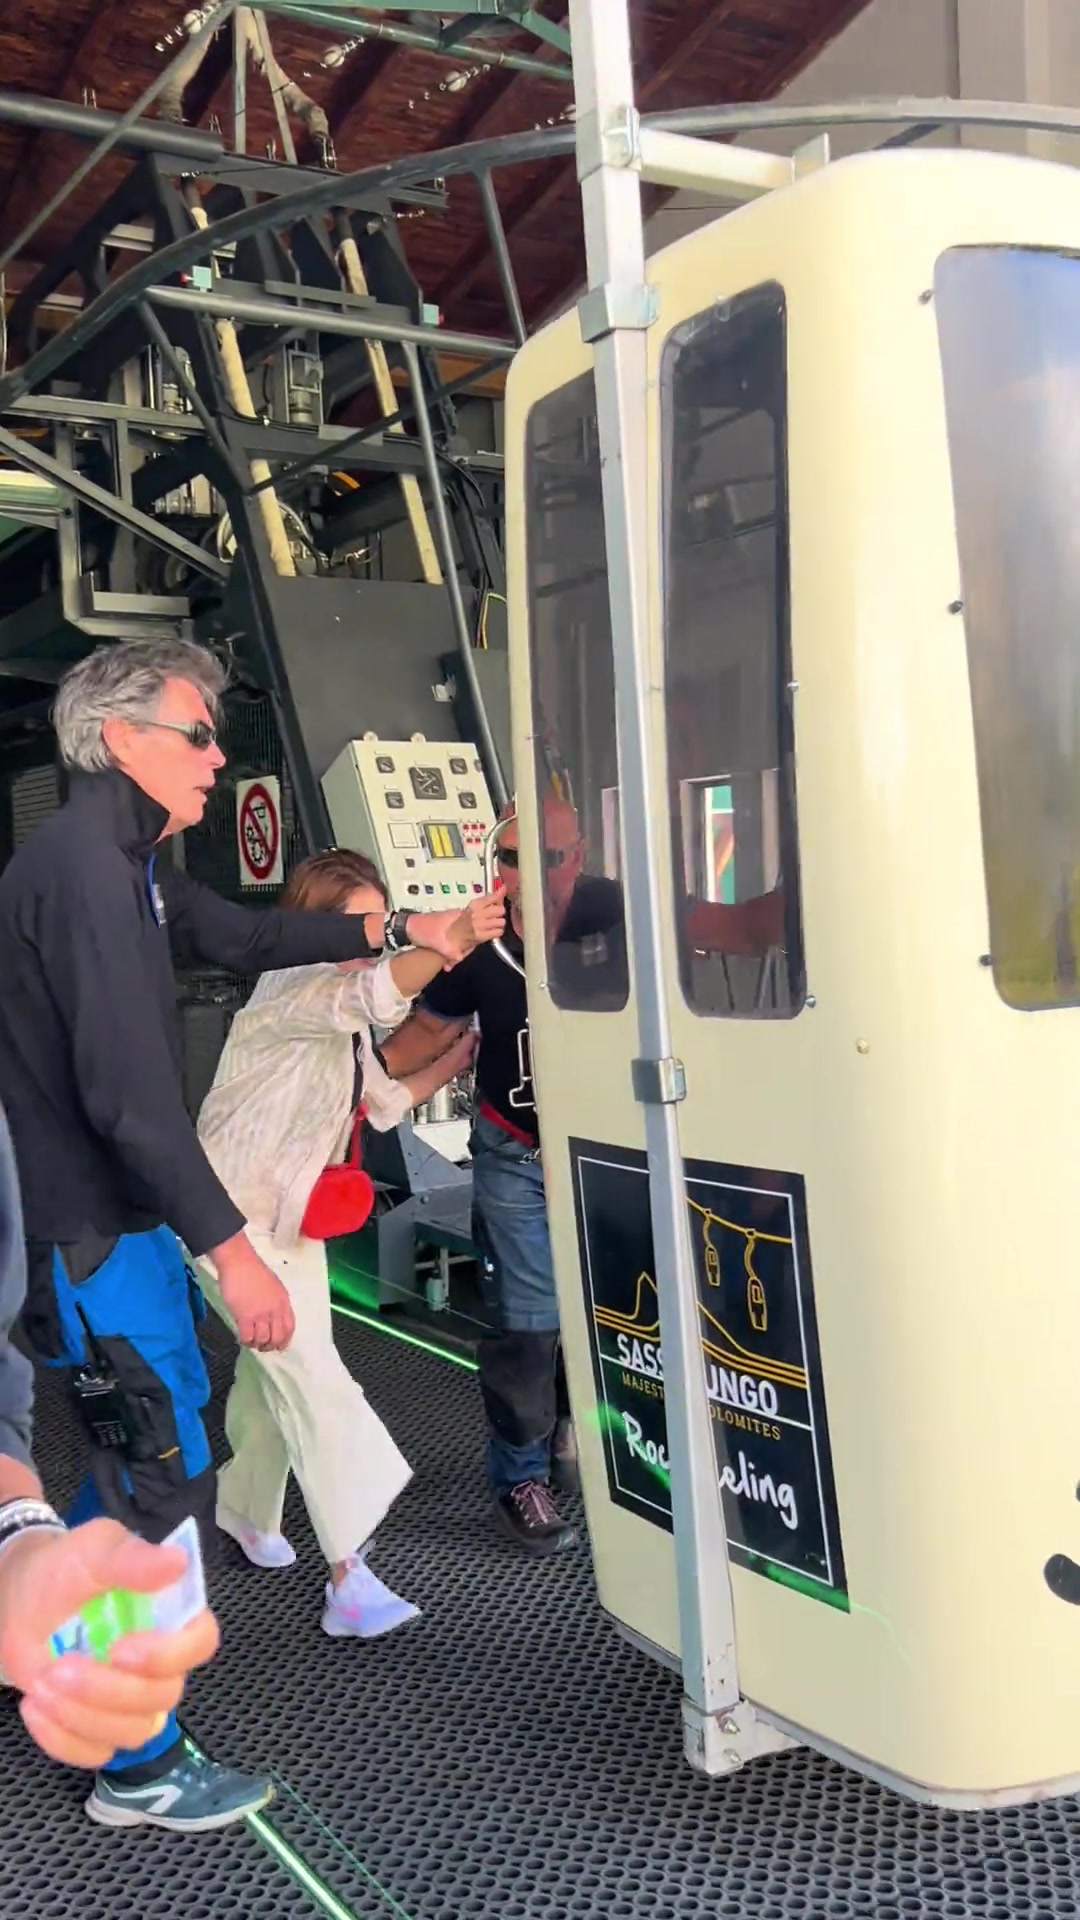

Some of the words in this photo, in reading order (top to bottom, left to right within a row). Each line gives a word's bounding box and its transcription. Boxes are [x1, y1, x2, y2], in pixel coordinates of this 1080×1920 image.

[622, 1371, 664, 1399] MAJEST
[708, 1404, 781, 1440] OLOMITES
[622, 1411, 671, 1469] Roc
[718, 1450, 798, 1530] eling
